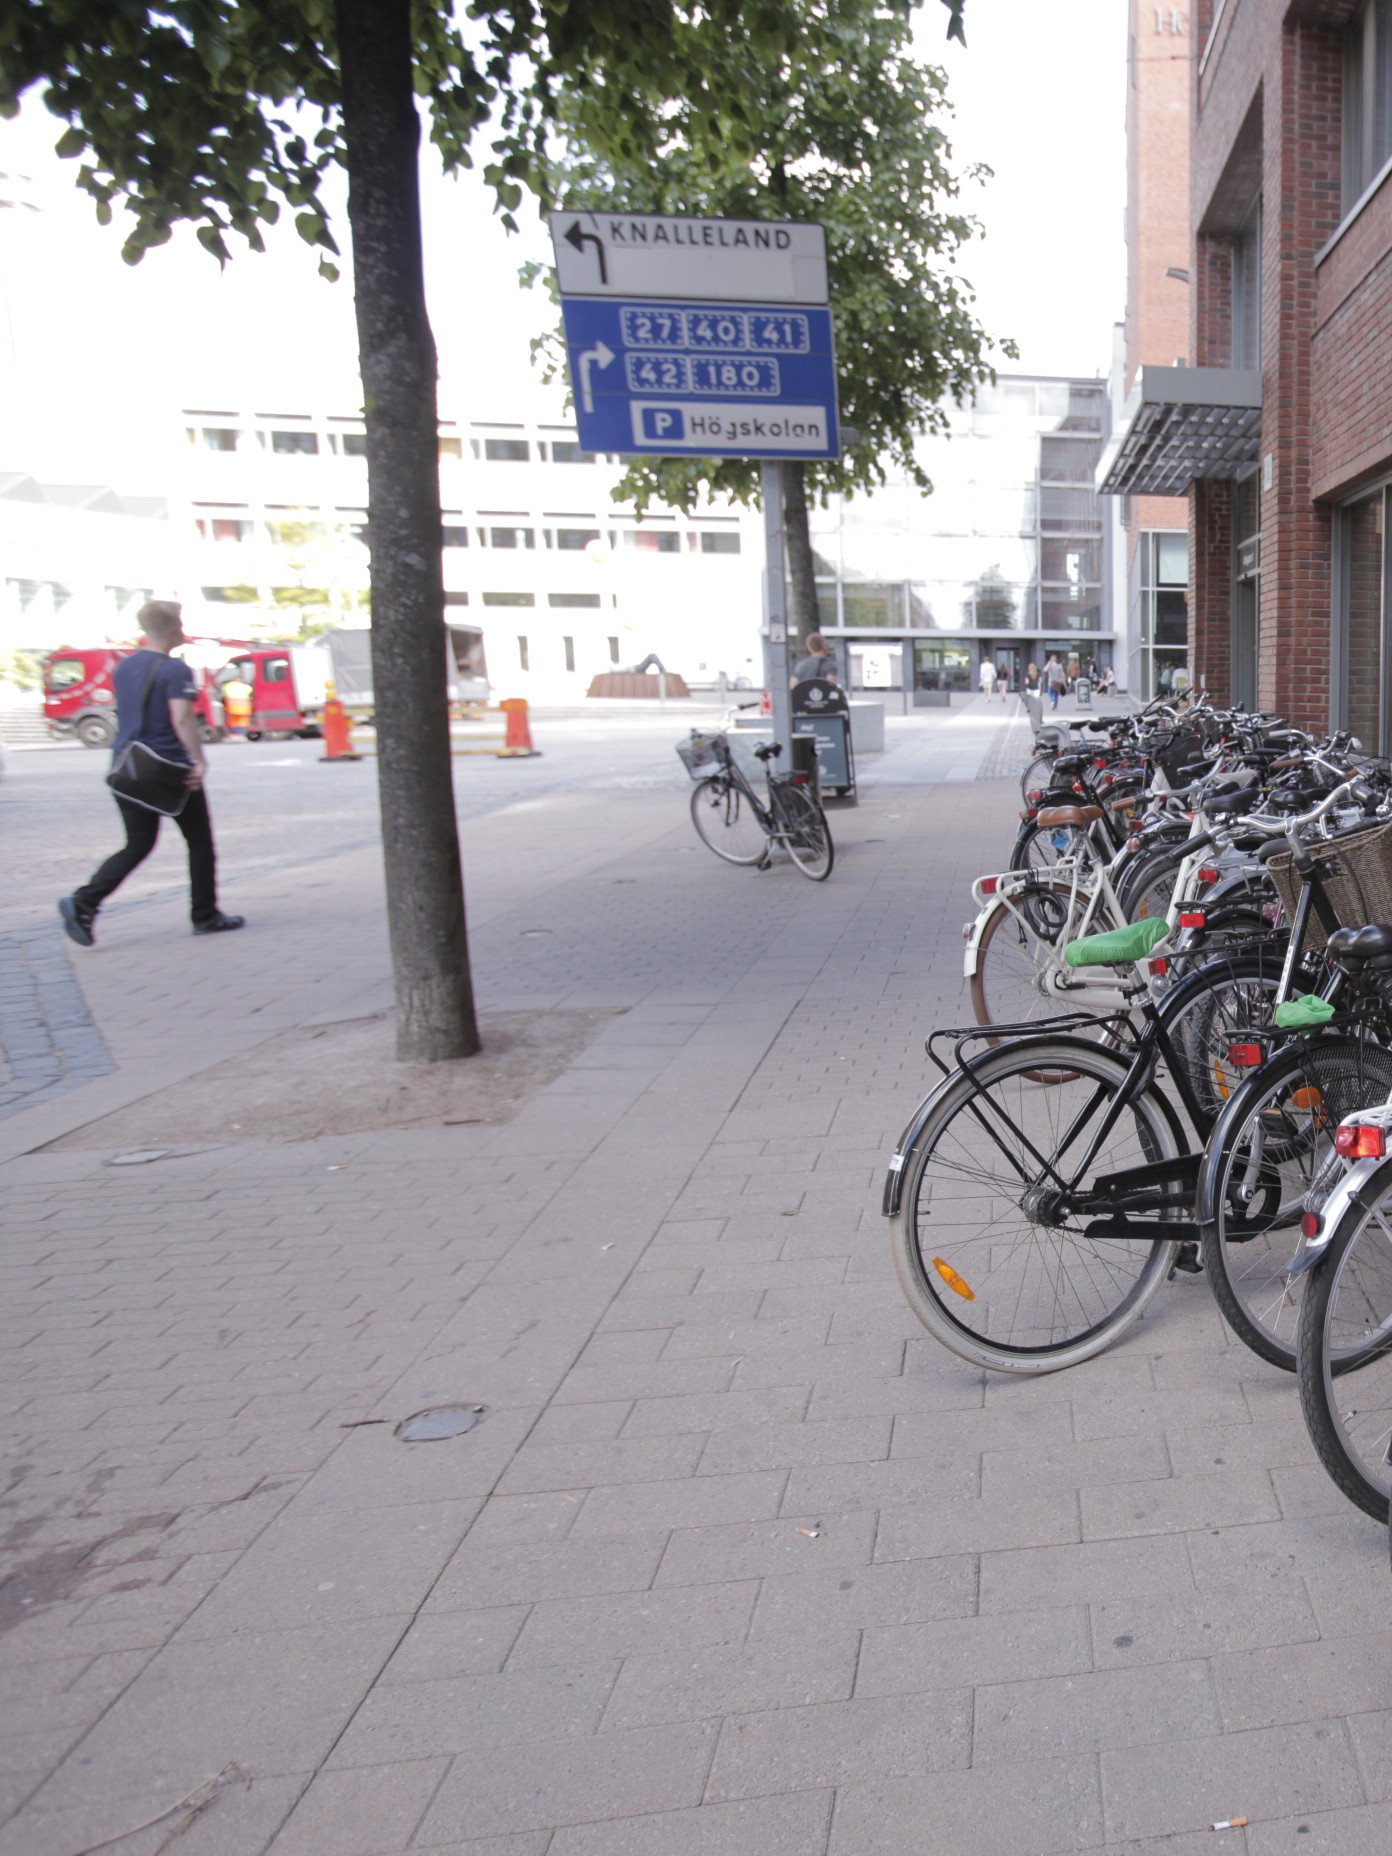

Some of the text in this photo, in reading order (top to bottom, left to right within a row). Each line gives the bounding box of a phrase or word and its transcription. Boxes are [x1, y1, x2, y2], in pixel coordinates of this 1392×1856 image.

[611, 221, 792, 250] KNALLELAND
[635, 318, 793, 344] 27 40 41
[639, 363, 760, 386] 42 180
[654, 412, 820, 440] P Högskolan
